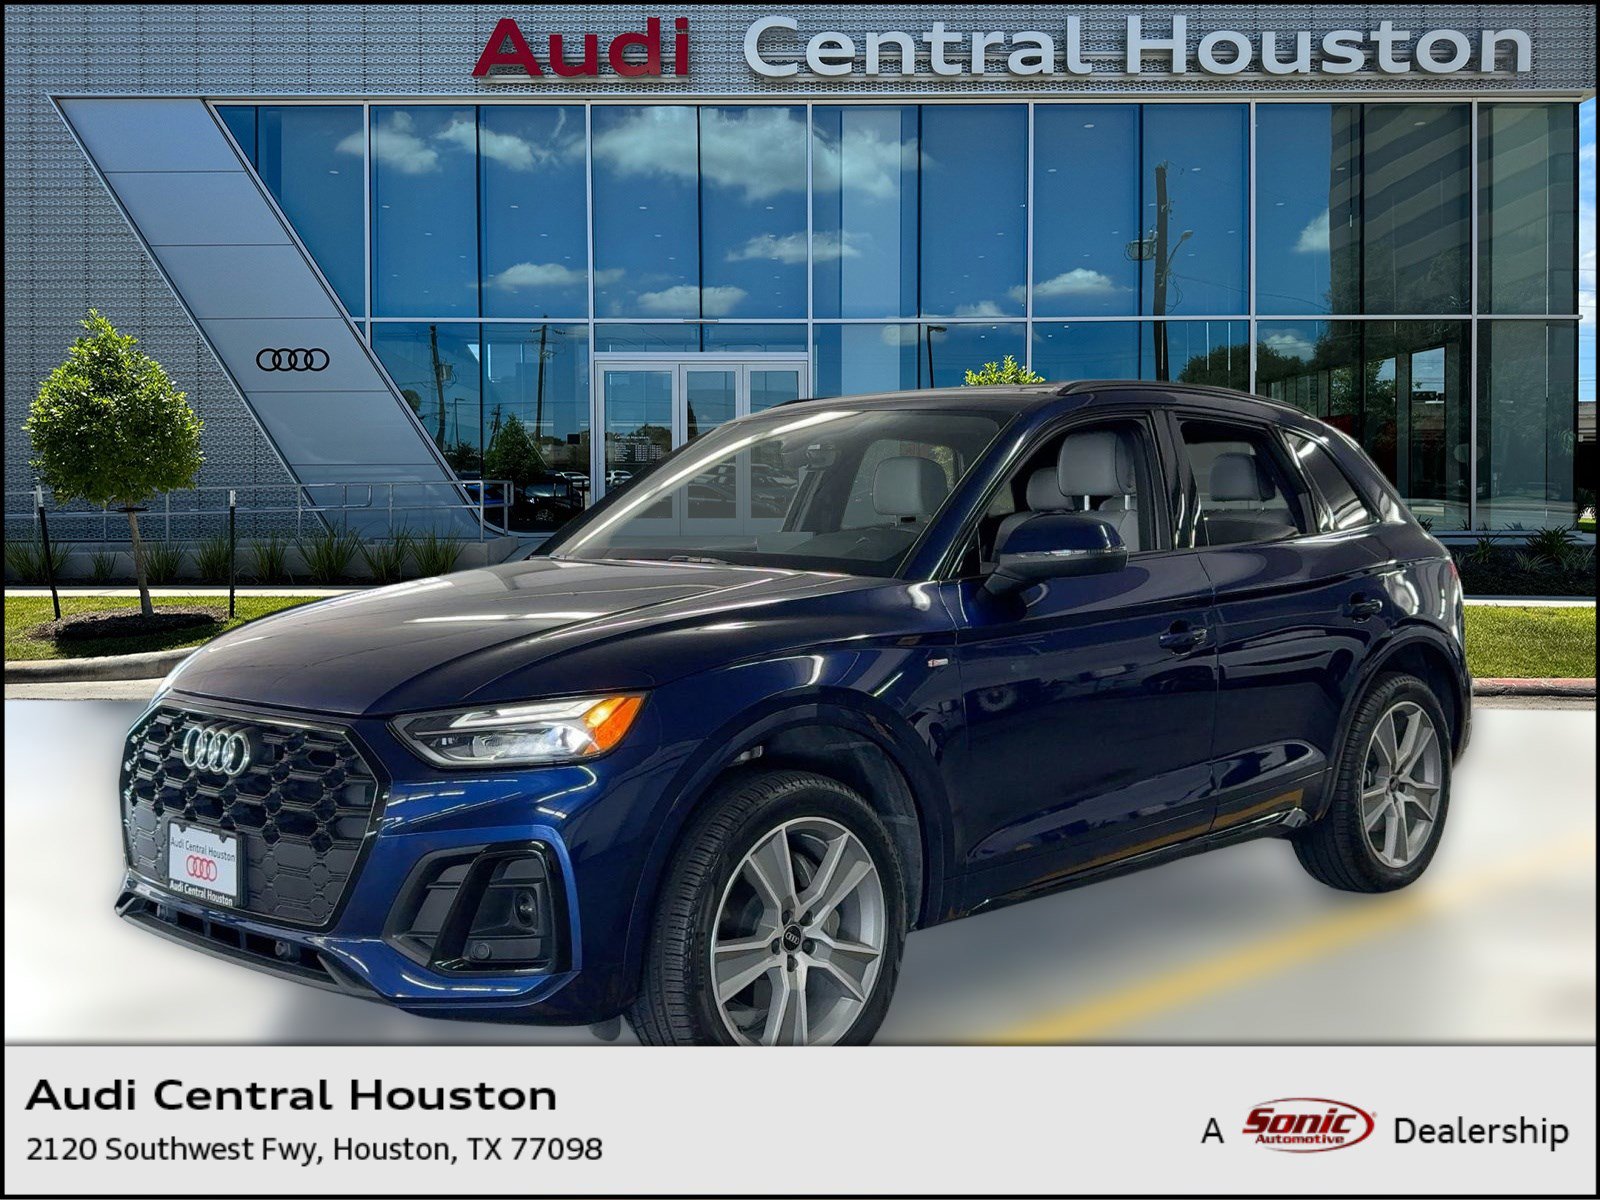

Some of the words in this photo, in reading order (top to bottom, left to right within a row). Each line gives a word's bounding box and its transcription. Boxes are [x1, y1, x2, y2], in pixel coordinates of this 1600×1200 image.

[471, 17, 689, 78] Audi
[743, 16, 1092, 77] Central
[1126, 15, 1532, 75] Houston
[170, 837, 185, 849] Audi
[185, 840, 207, 855] Central
[208, 846, 236, 862] Houston
[169, 880, 184, 894] Audi
[184, 884, 207, 900] Central
[207, 890, 233, 907] Houston
